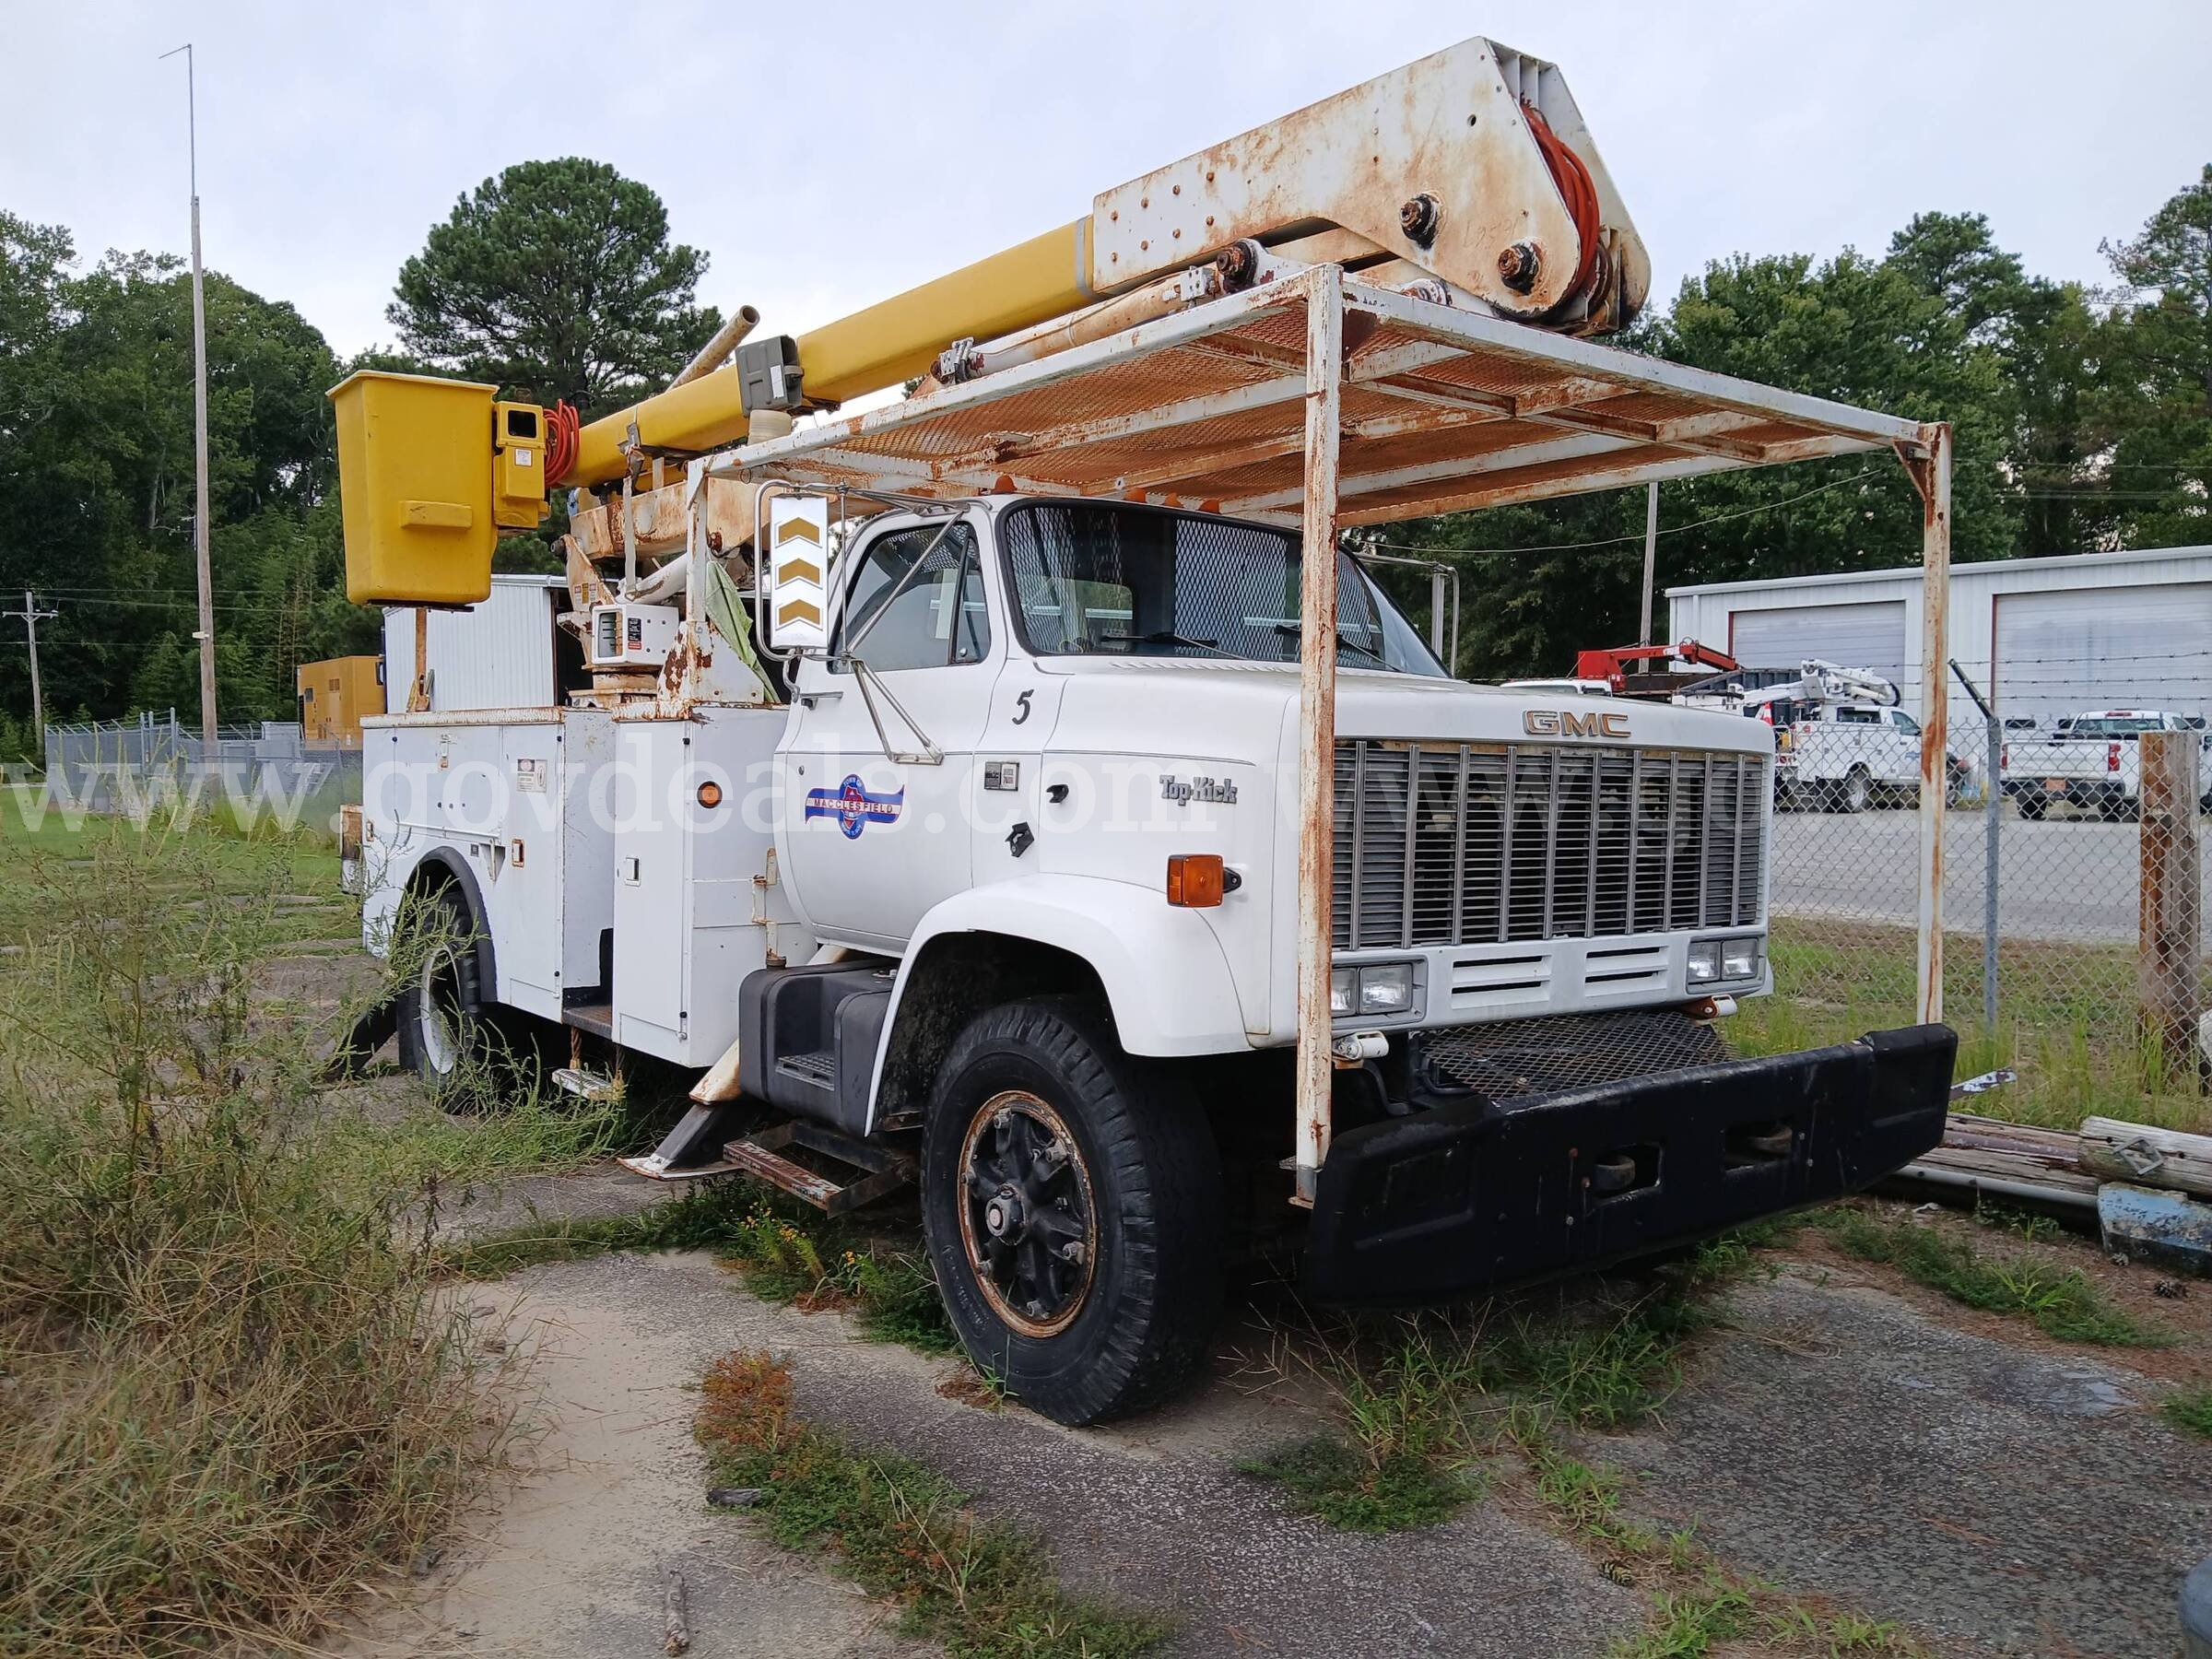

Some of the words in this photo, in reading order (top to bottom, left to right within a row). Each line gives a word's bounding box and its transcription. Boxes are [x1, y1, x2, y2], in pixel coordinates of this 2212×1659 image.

[1012, 688, 1034, 724] 5
[1523, 711, 1631, 737] GMC
[814, 798, 893, 814] MACCLESFIELD
